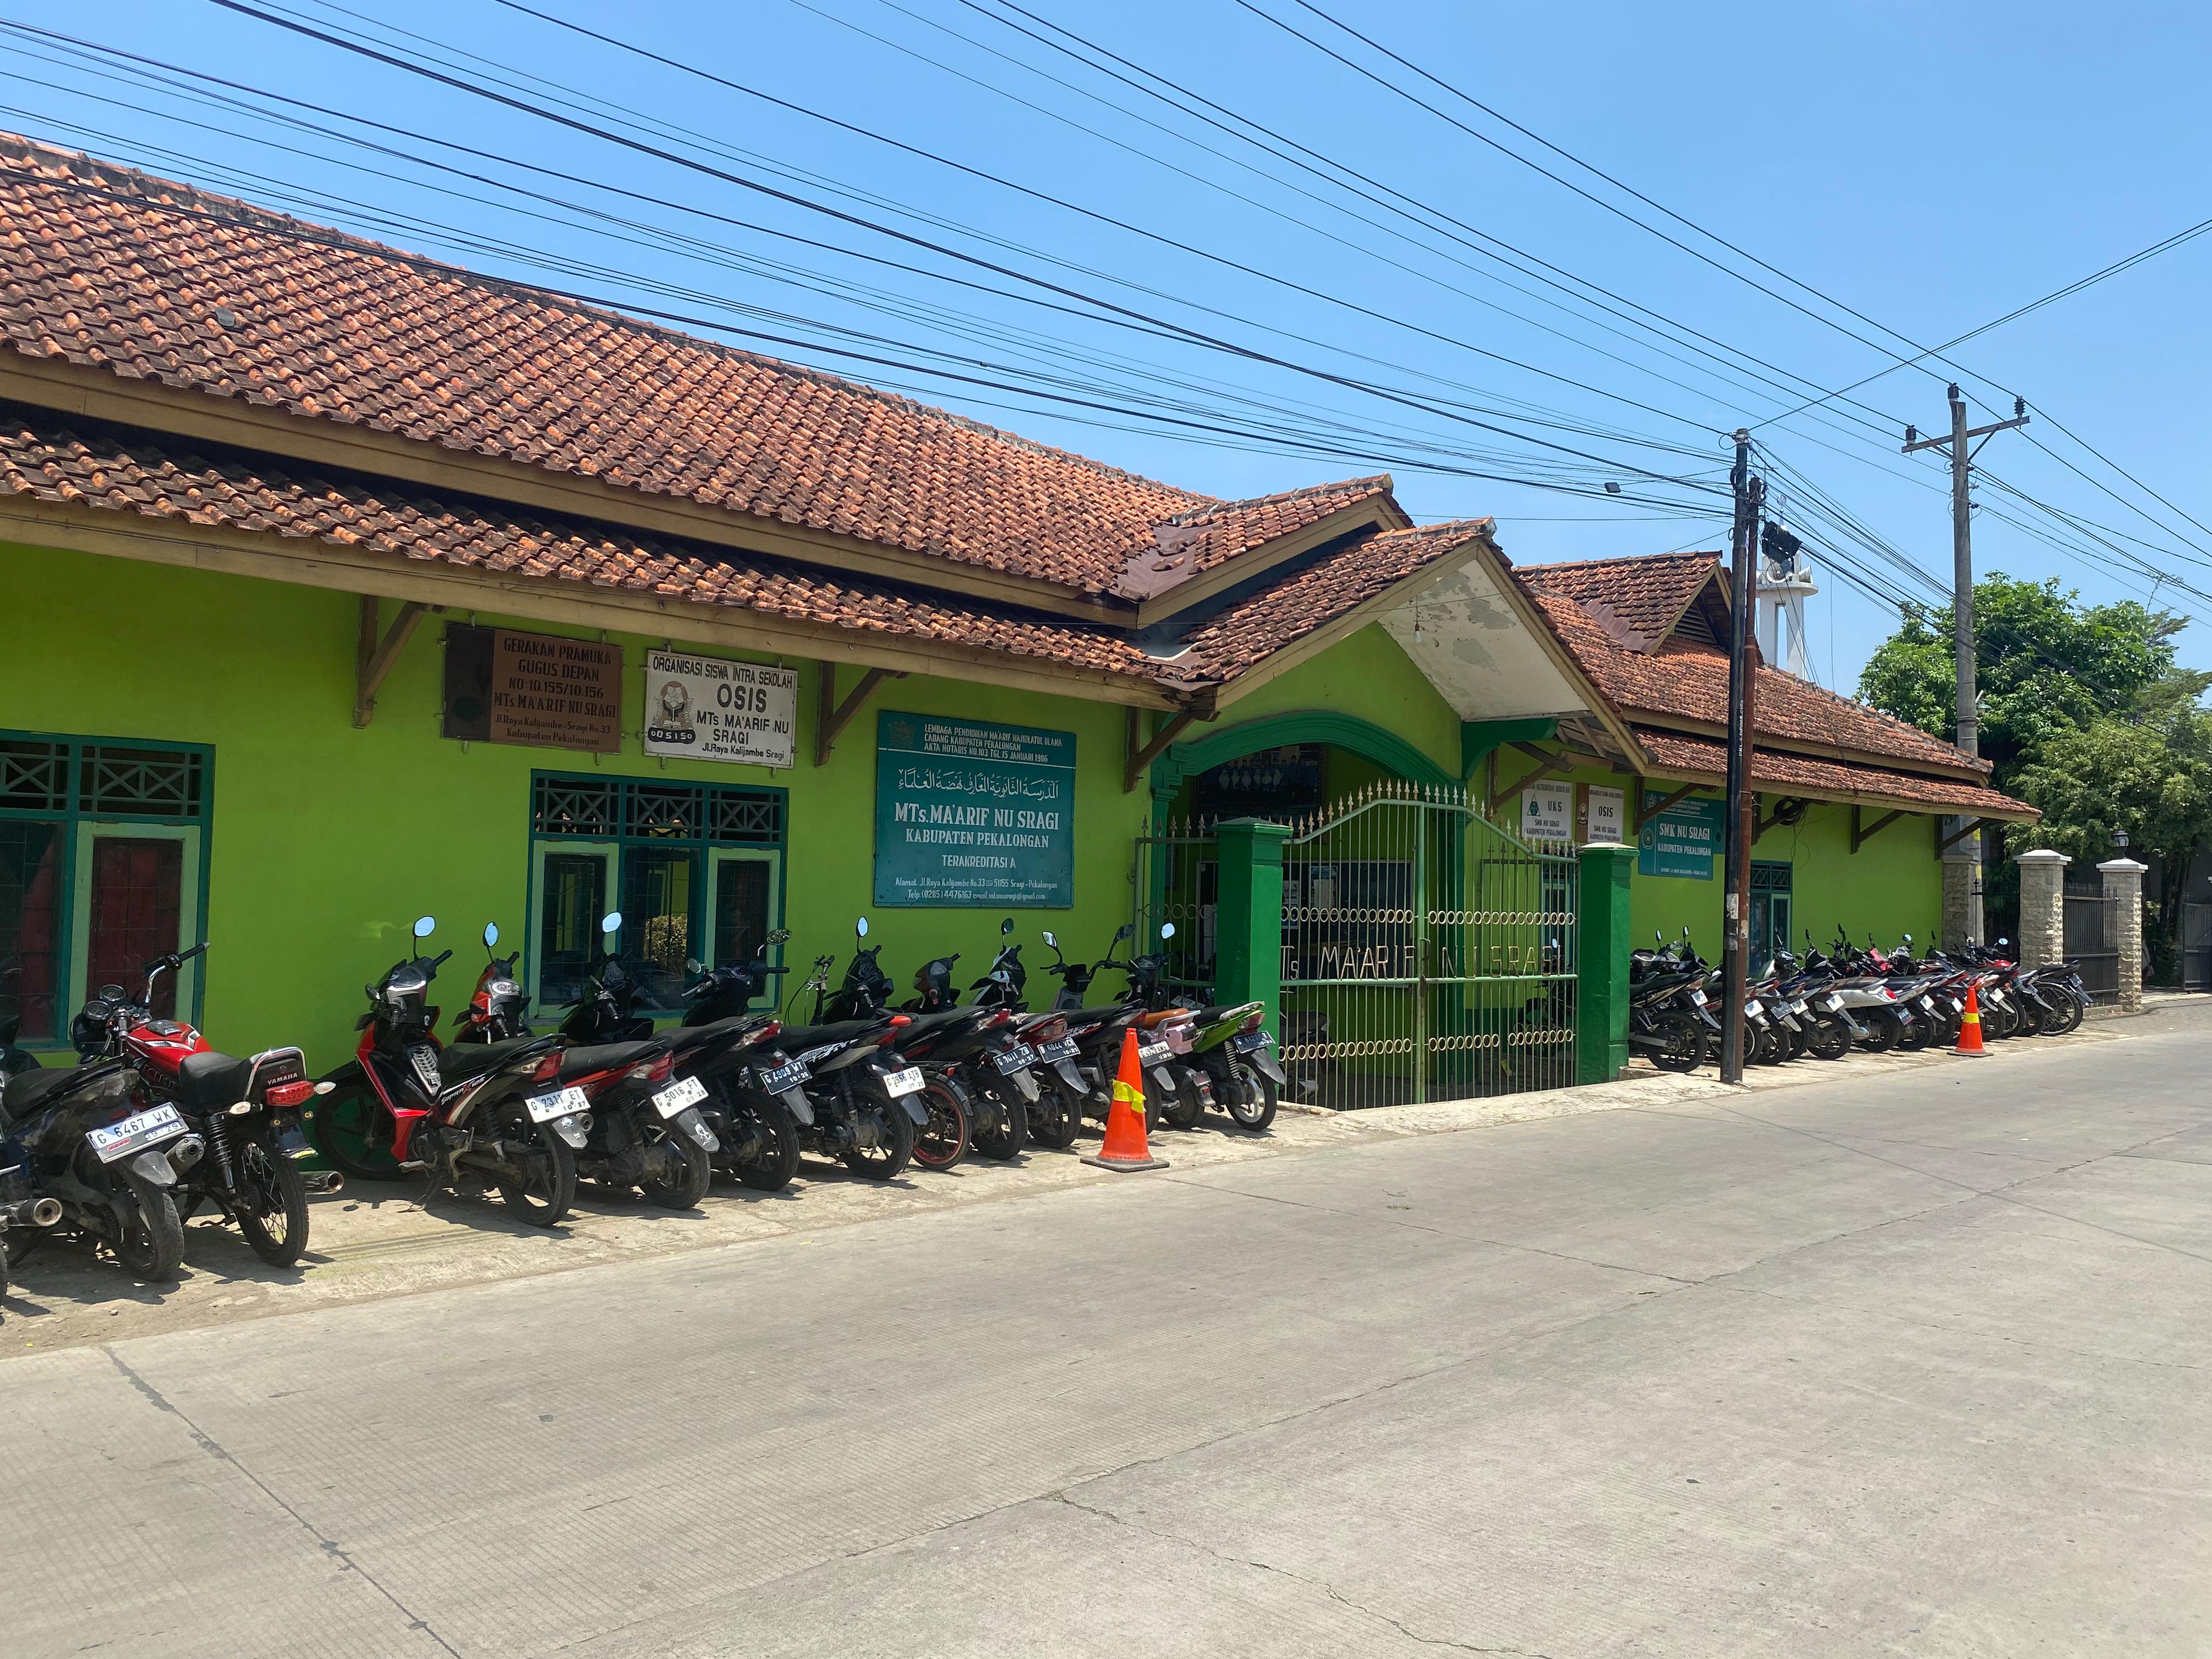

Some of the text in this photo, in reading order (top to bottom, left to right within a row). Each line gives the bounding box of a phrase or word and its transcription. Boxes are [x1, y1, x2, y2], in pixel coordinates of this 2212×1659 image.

[504, 637, 611, 665] GERAKAN PRAMUKA
[518, 659, 599, 681] GUGUS DEPAN
[653, 656, 792, 689] ORGANISASI SISWA INTRA SEKOLAH
[717, 683, 767, 713] OSIS
[568, 700, 583, 714] NU
[585, 703, 616, 718] SRAGI
[696, 710, 789, 734] MTs MA'ARIF NU
[507, 727, 599, 746] Kabupaten Pekalongan
[713, 729, 749, 744] SRAGI
[924, 724, 952, 735] LEMBAGA
[954, 727, 988, 739] PENDIDIKAN
[989, 730, 1011, 742] MA'ARIF
[1045, 737, 1062, 747] ULAMA
[924, 733, 1021, 751] CABANG KABUPATEN PEKALONGAN
[731, 746, 764, 758] Kalijambe
[766, 750, 784, 761] Sragi
[924, 742, 940, 752] AKTA
[942, 744, 967, 755] NOTARIS
[1009, 751, 1034, 761] JANUARI
[1035, 753, 1048, 763] 1986
[1548, 800, 1562, 812] UKS
[1598, 806, 1613, 817] OSIS
[994, 809, 1014, 827] NU
[1017, 810, 1059, 830] SRAGI
[905, 828, 1049, 848] KABUPATEN PEKALONGAN
[1659, 823, 1710, 840] SMK NU SRAGI
[1657, 842, 1711, 856] KABUPATEN PEKALONGAN
[942, 855, 1017, 868] TERAKREDITASI A
[942, 878, 969, 889] Kalijambe
[994, 879, 1009, 887] 51155
[1442, 945, 1477, 979] NU
[1046, 1041, 1063, 1052] 6044
[996, 1058, 1003, 1066] G
[1019, 1046, 1030, 1056] ZB
[267, 1072, 298, 1085] YAMAHA
[764, 1074, 772, 1084] G
[892, 1073, 907, 1085] 3966
[541, 1094, 563, 1108] 2311
[568, 1090, 580, 1100] ET
[664, 1086, 685, 1101] 5016
[686, 1079, 698, 1090] FT
[97, 1134, 106, 1144] G
[114, 1118, 145, 1137] 6467
[153, 1109, 172, 1123] WK
